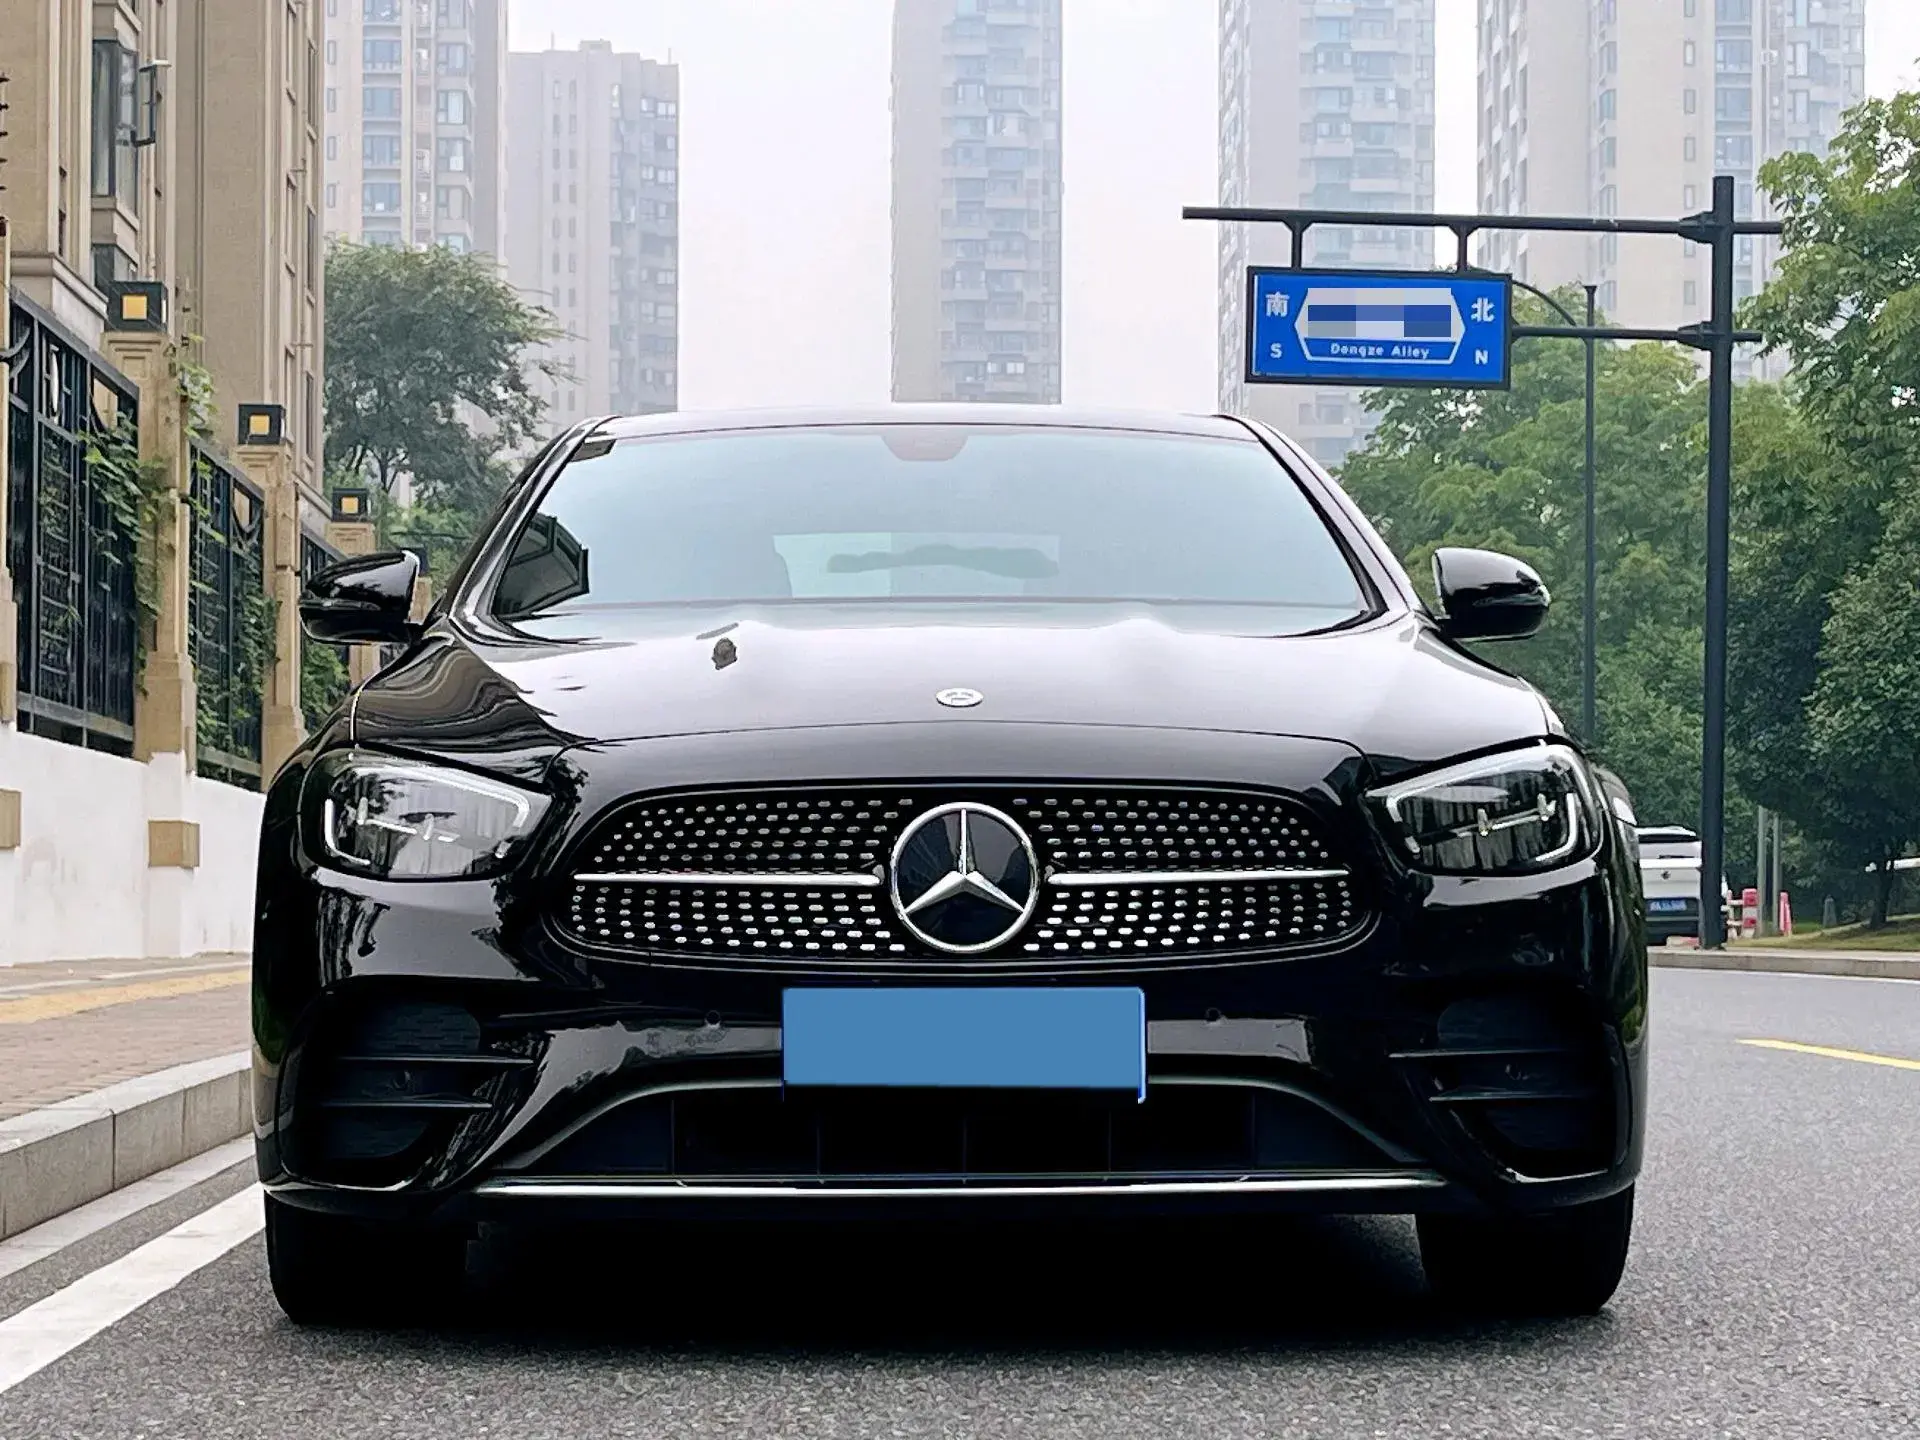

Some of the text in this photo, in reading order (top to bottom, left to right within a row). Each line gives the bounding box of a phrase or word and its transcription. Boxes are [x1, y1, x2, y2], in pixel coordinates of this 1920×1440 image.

[1265, 291, 1290, 317] 南
[1470, 297, 1495, 322] 北
[1270, 342, 1282, 359] S
[1391, 345, 1430, 360] Alley
[1475, 349, 1488, 365] N
